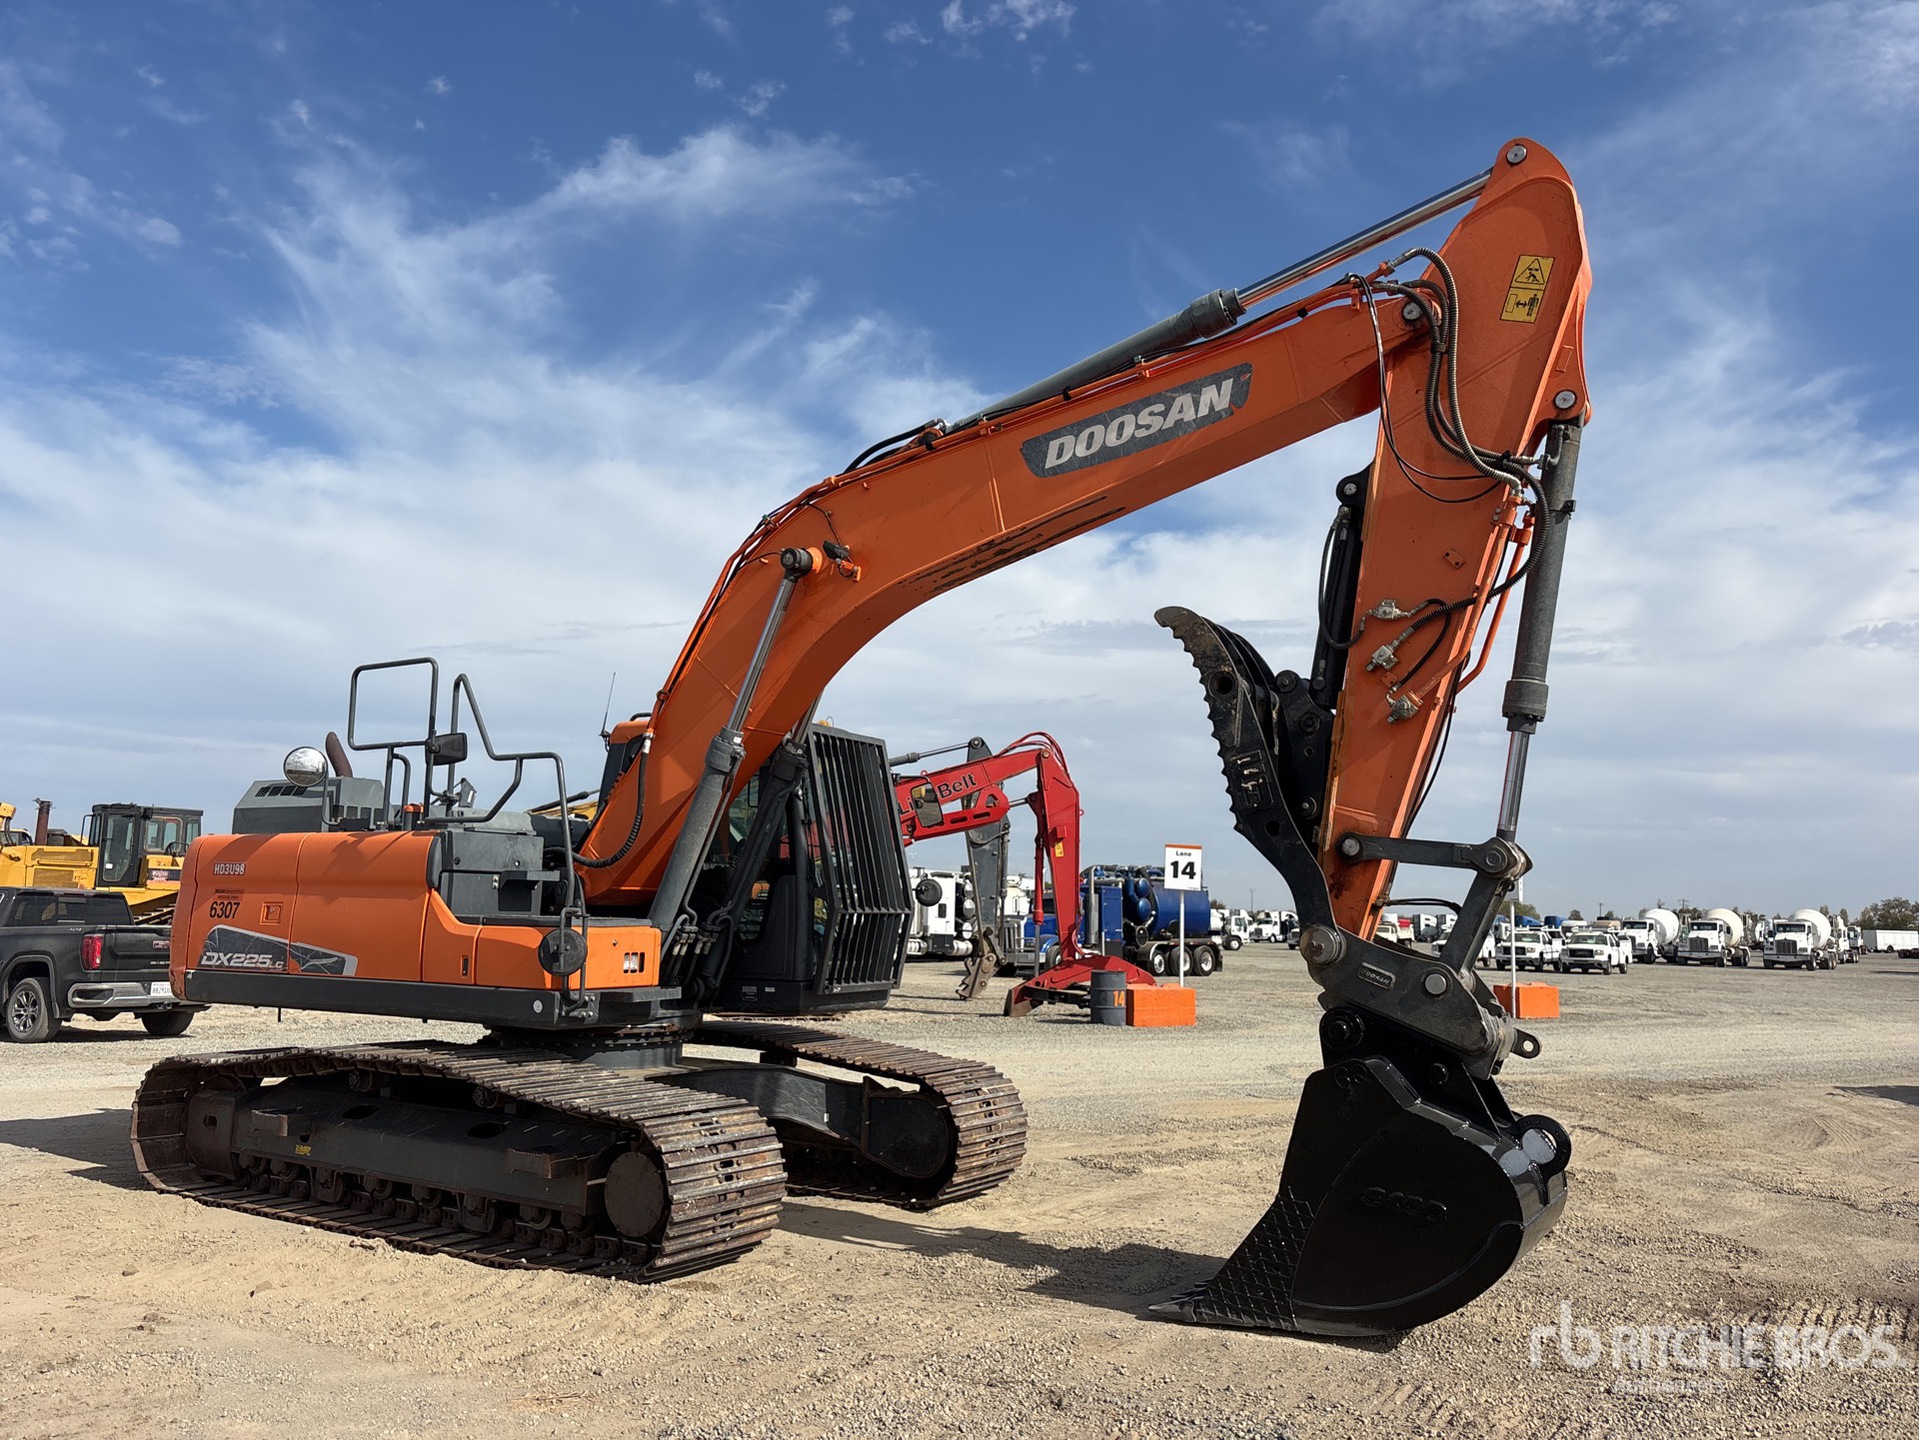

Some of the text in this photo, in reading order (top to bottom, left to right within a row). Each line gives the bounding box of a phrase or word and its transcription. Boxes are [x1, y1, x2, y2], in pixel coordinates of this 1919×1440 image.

[1045, 378, 1233, 469] DOOSAN
[214, 863, 246, 875] HD3U98
[1170, 860, 1197, 880] 14
[209, 901, 241, 919] 6307
[1113, 991, 1125, 1008] 14
